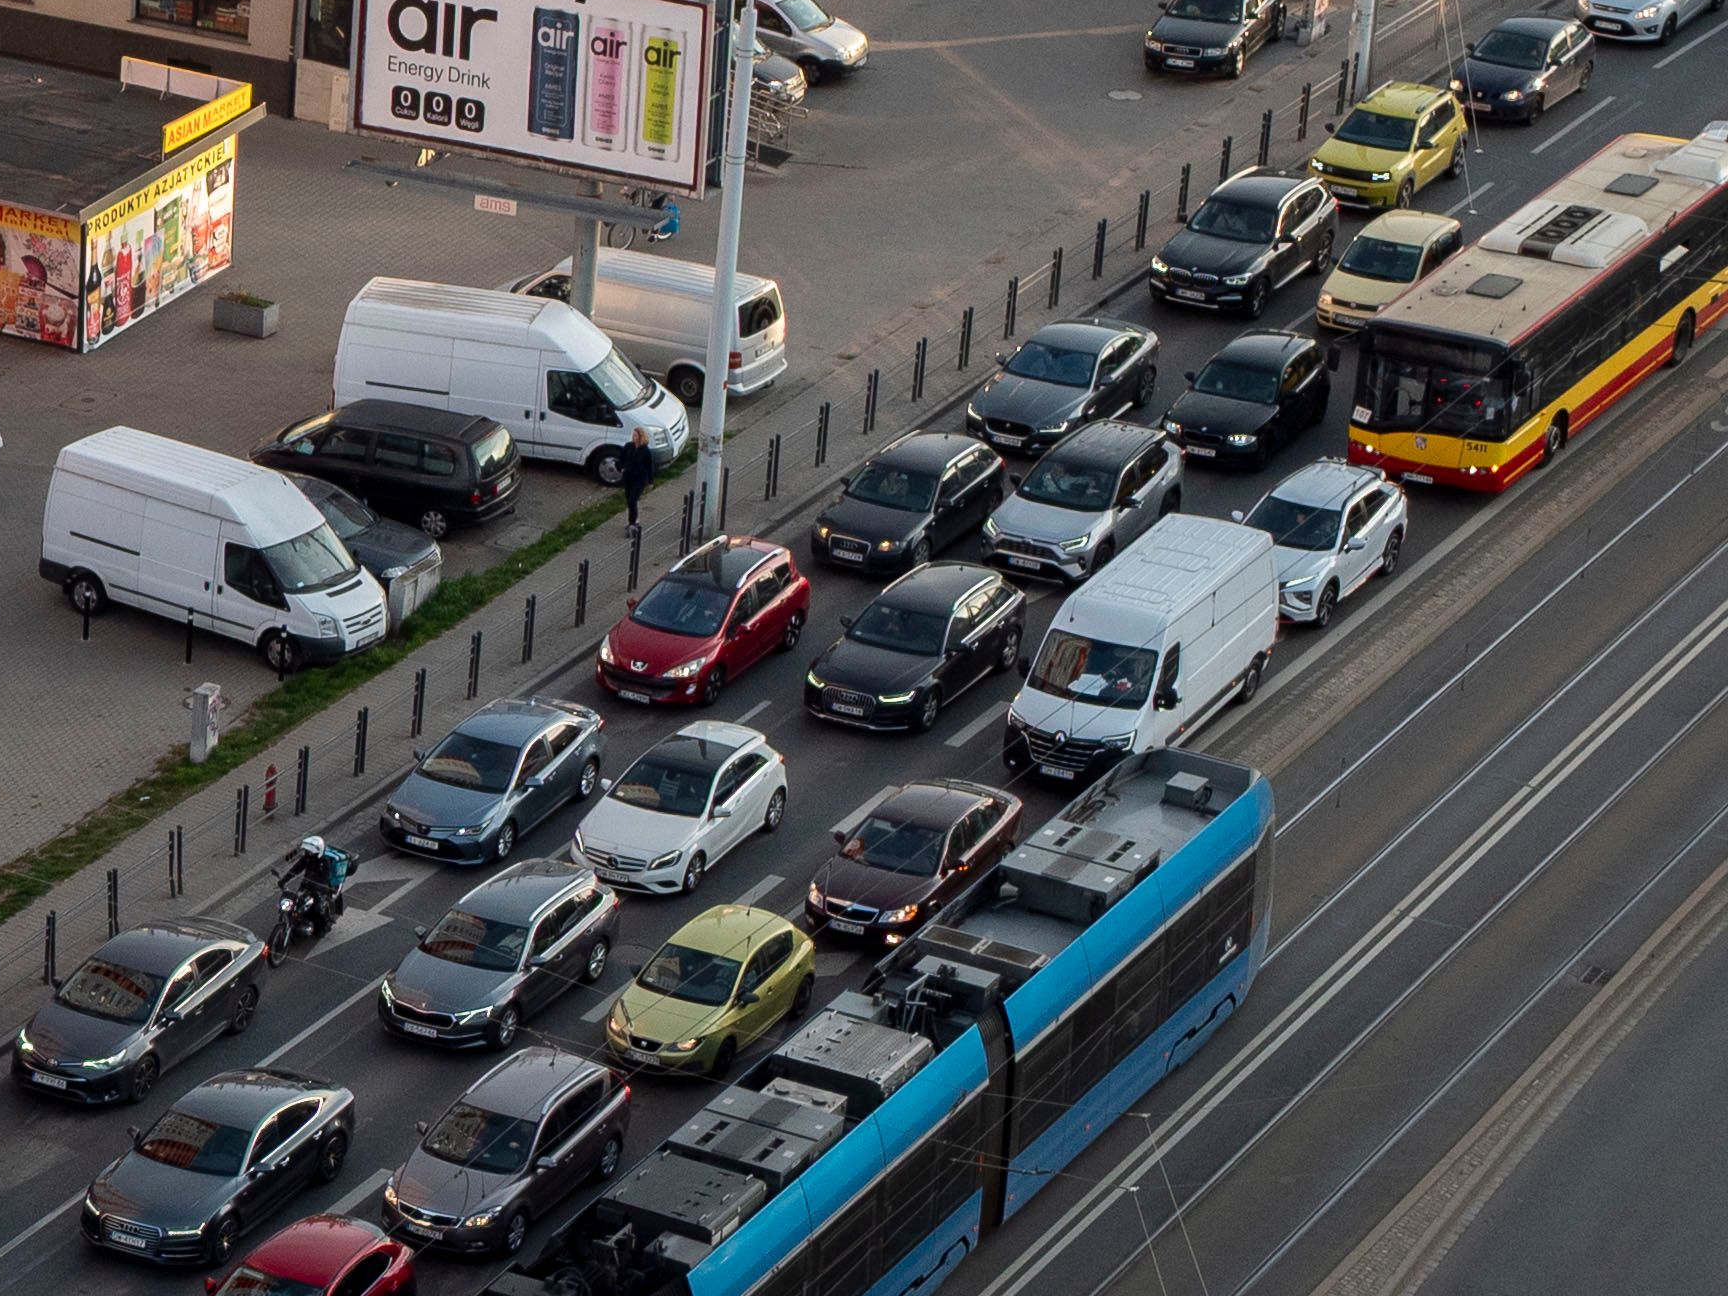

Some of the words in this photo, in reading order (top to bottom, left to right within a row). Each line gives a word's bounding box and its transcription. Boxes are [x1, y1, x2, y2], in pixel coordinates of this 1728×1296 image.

[537, 22, 575, 50] air
[590, 32, 628, 59] air
[644, 41, 682, 69] air
[387, 55, 444, 83] Energy
[448, 66, 492, 90] Drink
[400, 90, 412, 107] 0
[432, 96, 444, 112] 0
[464, 103, 476, 119] 0
[168, 118, 201, 146] ASIAN
[86, 190, 150, 236] PRODUKTY
[154, 146, 223, 198] AZJATYCKIE
[479, 198, 511, 213] ams
[1466, 442, 1488, 453] 5411
